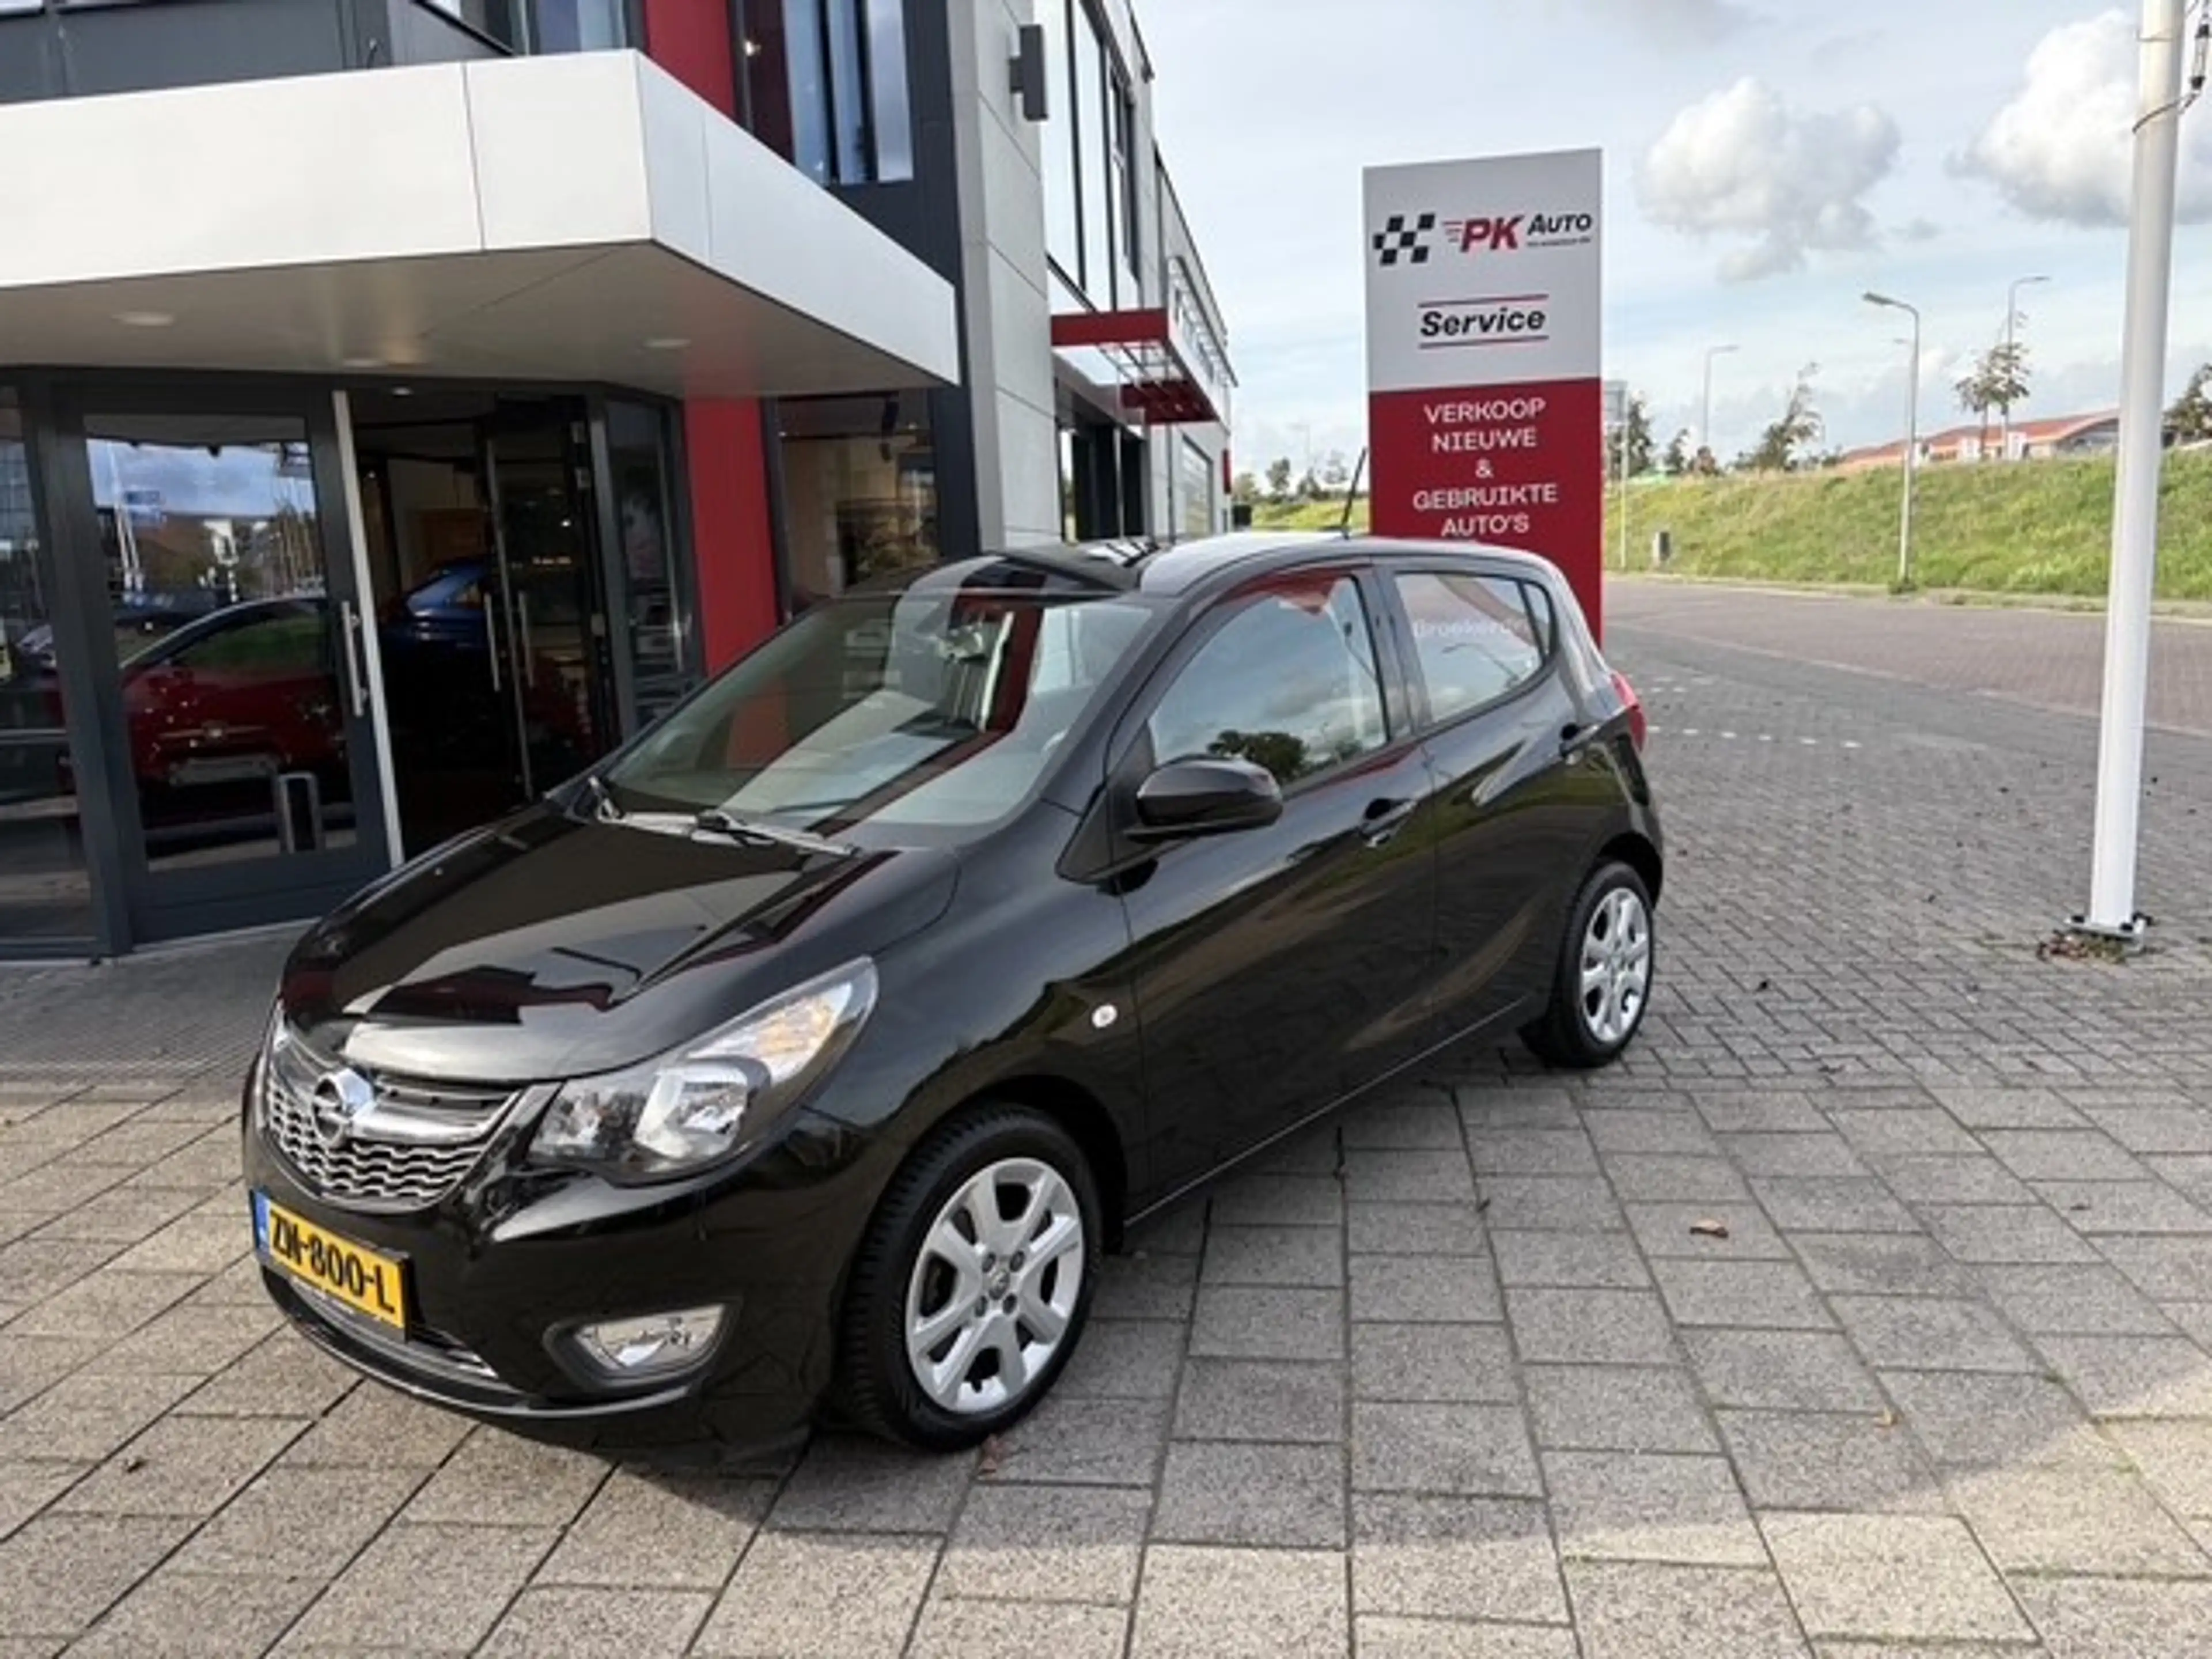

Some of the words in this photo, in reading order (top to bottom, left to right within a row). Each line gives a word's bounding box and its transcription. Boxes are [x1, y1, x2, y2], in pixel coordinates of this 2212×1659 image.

[1460, 215, 1525, 252] PK
[1419, 307, 1546, 337] Service
[1423, 397, 1546, 424] VERKOOP
[1431, 427, 1537, 452] NIEUWE
[1475, 459, 1494, 478] &
[1412, 483, 1558, 512] GEBRUIKTE
[1441, 512, 1530, 537] AUTO'S
